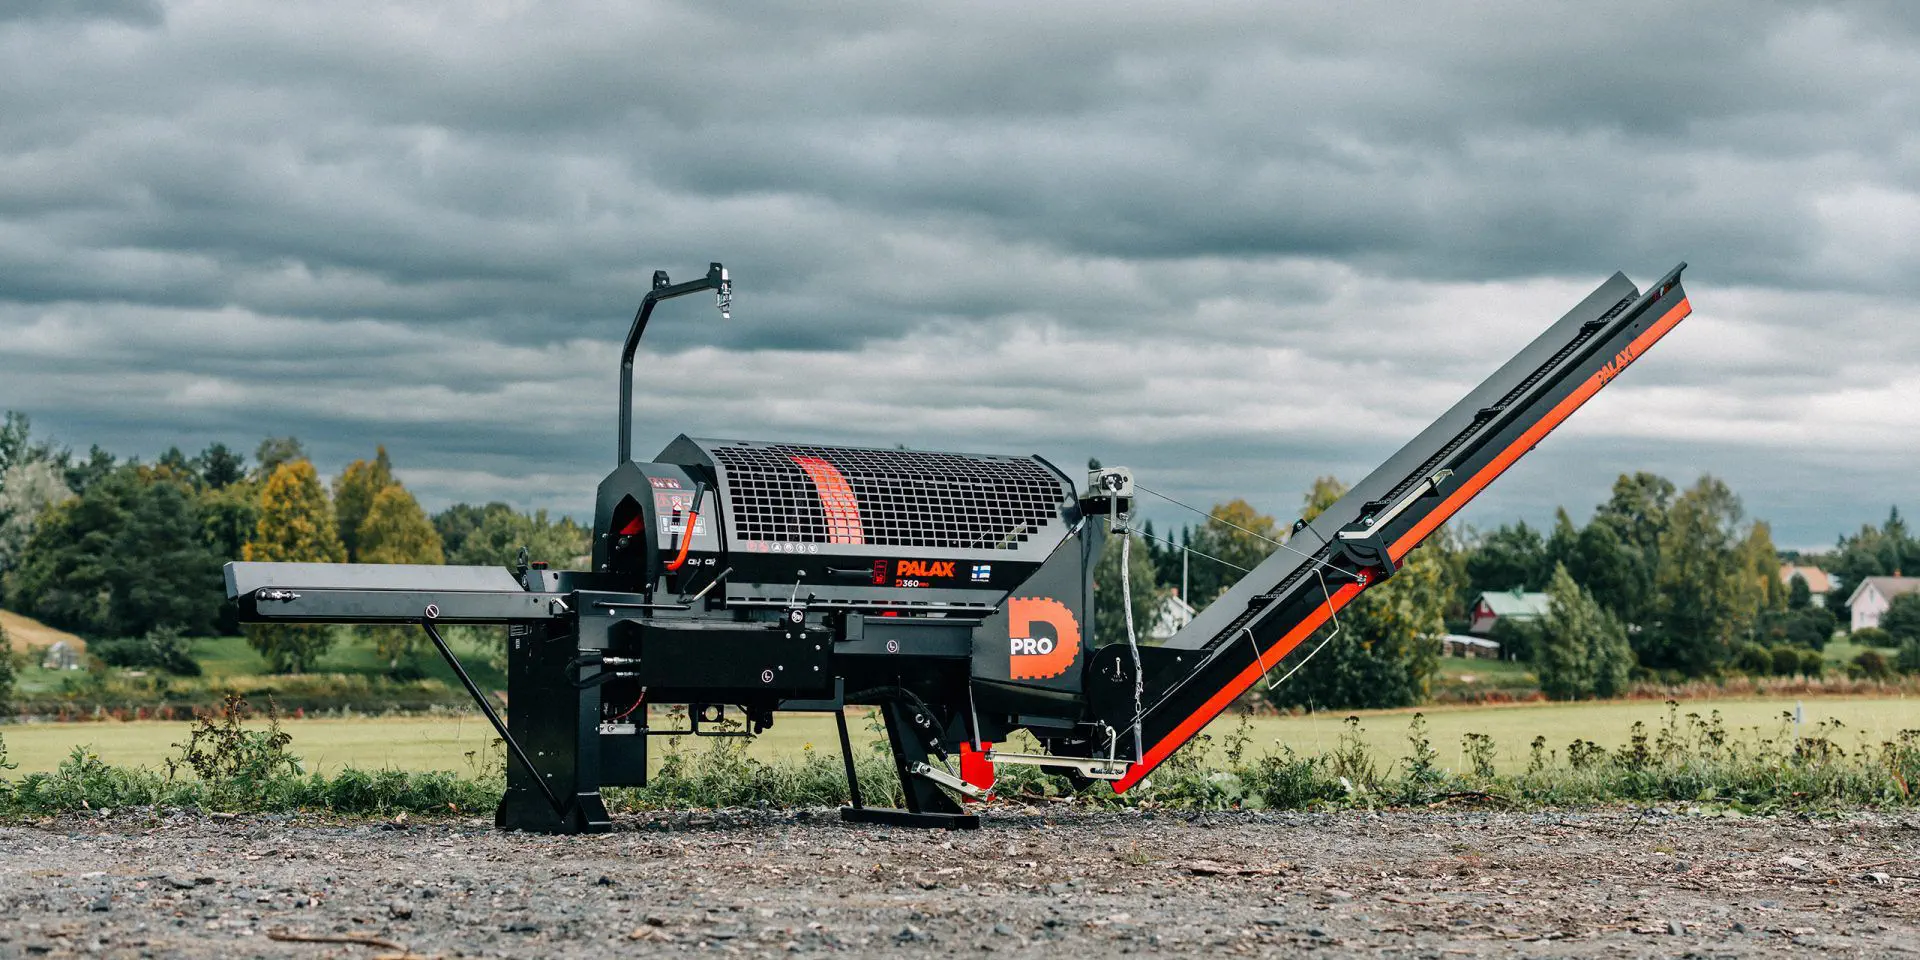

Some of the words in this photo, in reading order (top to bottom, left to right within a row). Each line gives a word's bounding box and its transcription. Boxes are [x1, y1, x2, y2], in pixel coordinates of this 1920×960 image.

[1596, 345, 1633, 384] PALAX
[896, 560, 954, 577] PALAX
[1010, 638, 1053, 655] PRO
